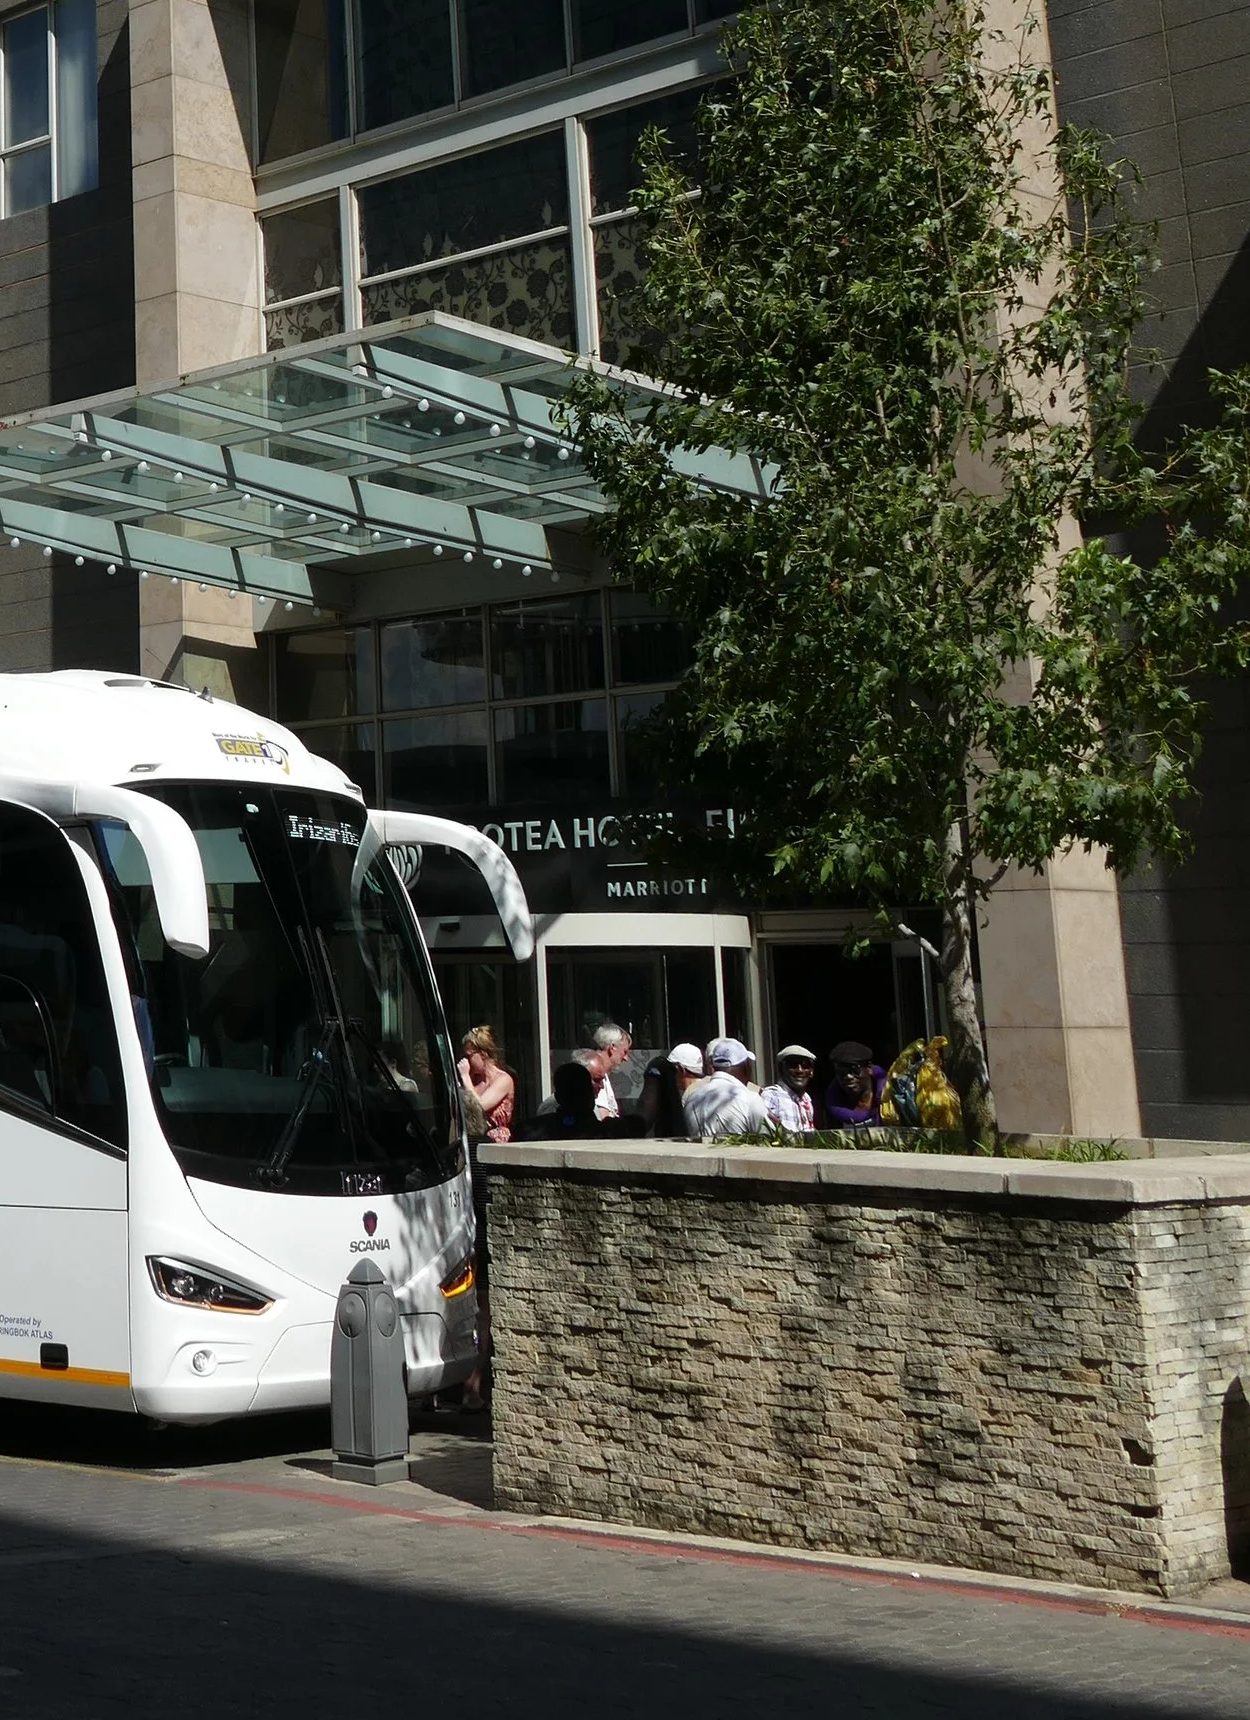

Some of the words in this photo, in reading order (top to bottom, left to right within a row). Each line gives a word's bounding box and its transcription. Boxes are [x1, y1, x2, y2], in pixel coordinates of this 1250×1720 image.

[221, 740, 263, 756] GATE
[350, 1239, 391, 1253] SCANIA
[0, 1314, 31, 1326] Operated
[33, 1317, 42, 1328] by
[30, 1330, 53, 1340] ATLAS
